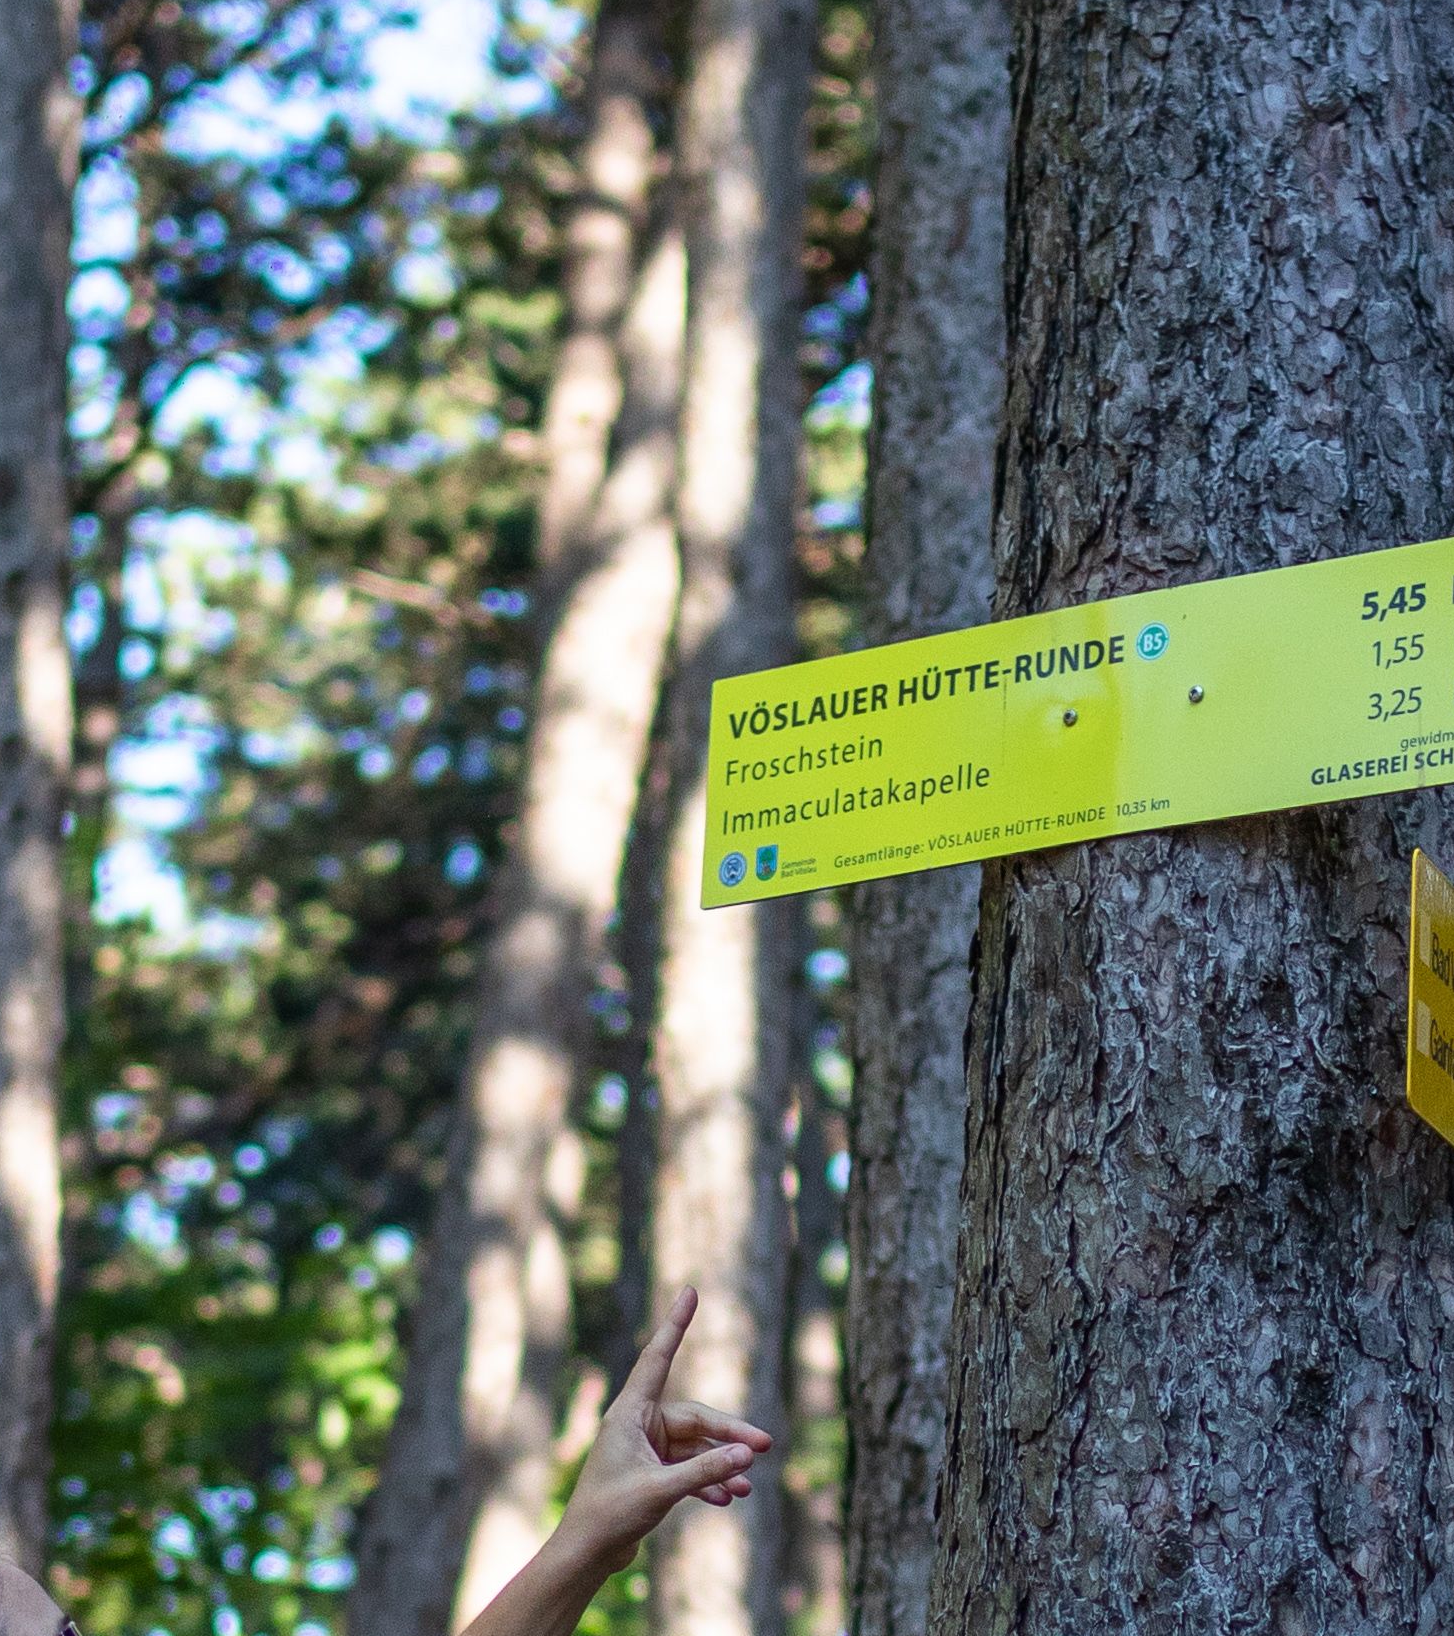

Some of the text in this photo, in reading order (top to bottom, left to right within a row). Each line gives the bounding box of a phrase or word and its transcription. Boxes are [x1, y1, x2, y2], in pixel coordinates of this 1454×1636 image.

[1361, 583, 1427, 622] 5,45
[1143, 632, 1163, 652] B5
[1371, 633, 1425, 669] 1,55
[729, 635, 1125, 739] VÖSLAUER HÜTTE-RUNDE
[1367, 686, 1422, 722] 3,25
[726, 735, 883, 786] Froschstein
[1311, 754, 1408, 786] GLASEREI
[723, 762, 990, 835] Immaculatakapelle
[833, 797, 1170, 869] Gesamtlänge: VÖSLAUER HÜTTE-RUNDE 10,35 km
[1432, 932, 1450, 987] Bad
